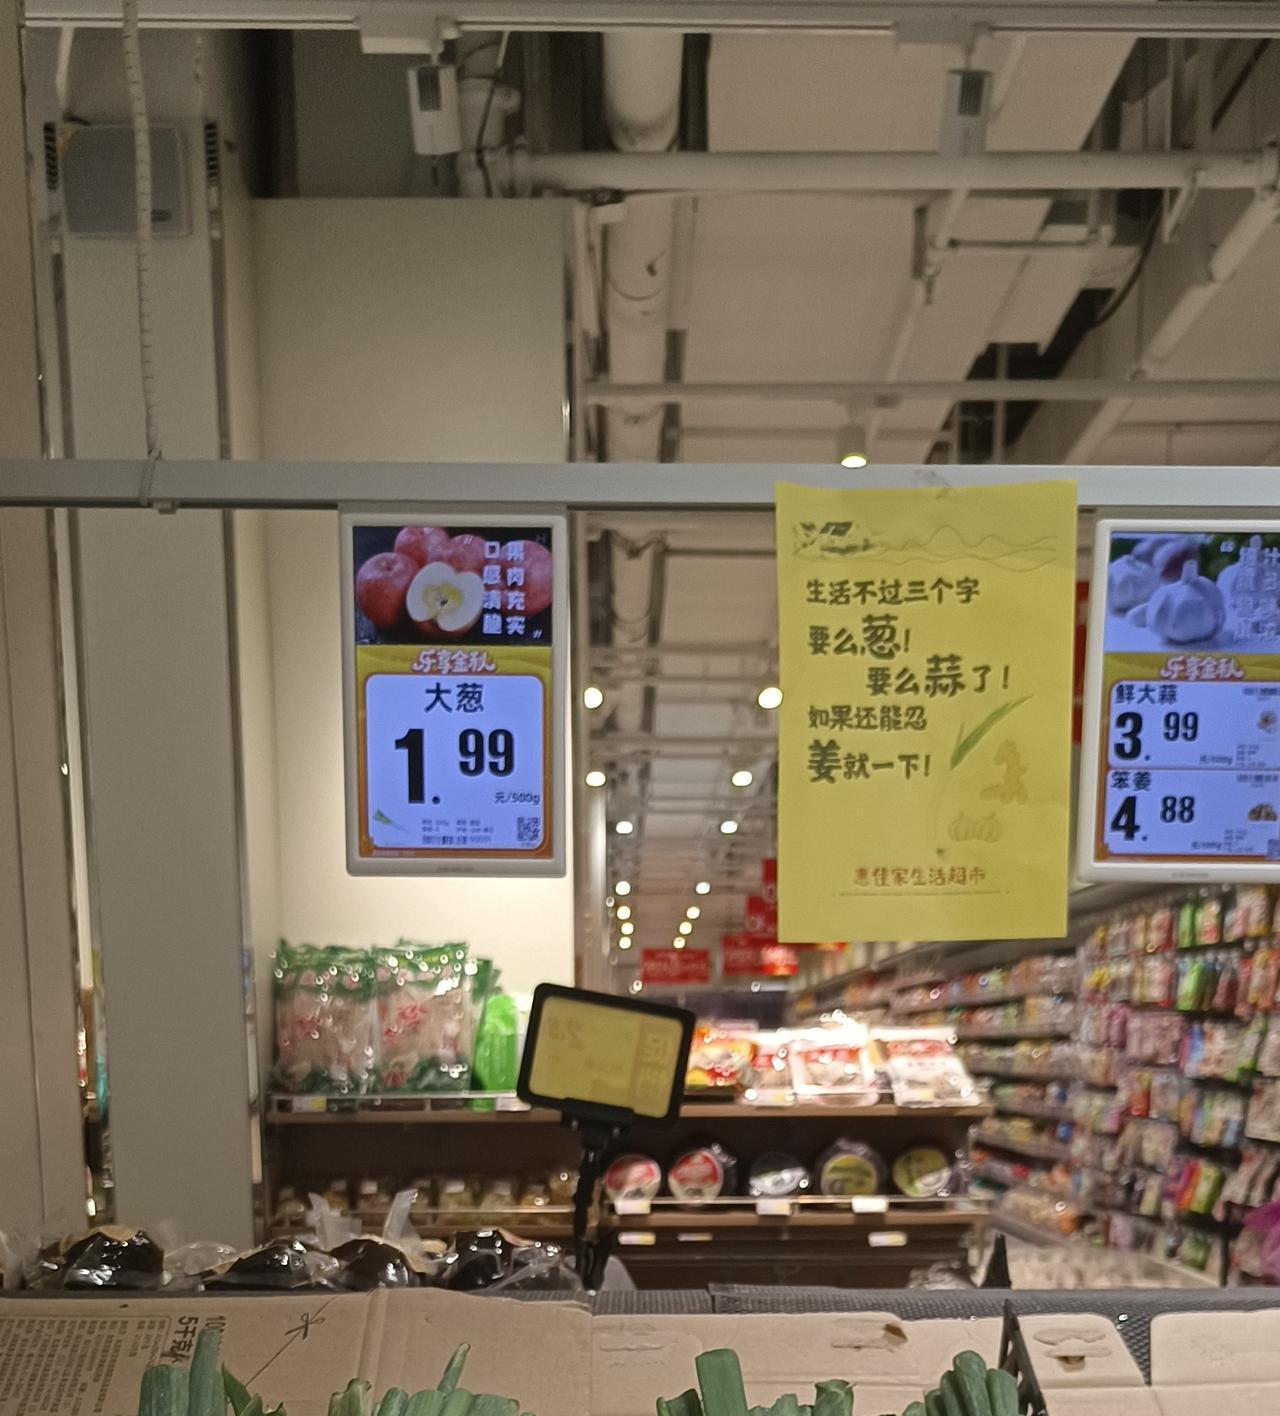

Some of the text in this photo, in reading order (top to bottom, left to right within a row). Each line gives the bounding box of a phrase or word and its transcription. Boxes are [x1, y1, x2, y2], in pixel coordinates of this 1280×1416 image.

[806, 577, 980, 605] 生活不过三个字
[412, 649, 495, 673] 乐享金秋
[1160, 655, 1244, 680] 乐享金秋
[424, 682, 484, 713] 大葱
[1116, 684, 1178, 704] 鲜大蒜
[808, 705, 927, 732] 如果还能忍
[1110, 771, 1152, 791] 笨姜
[494, 791, 541, 805] 元/500g
[854, 866, 986, 888] 惠佳家生活超市
